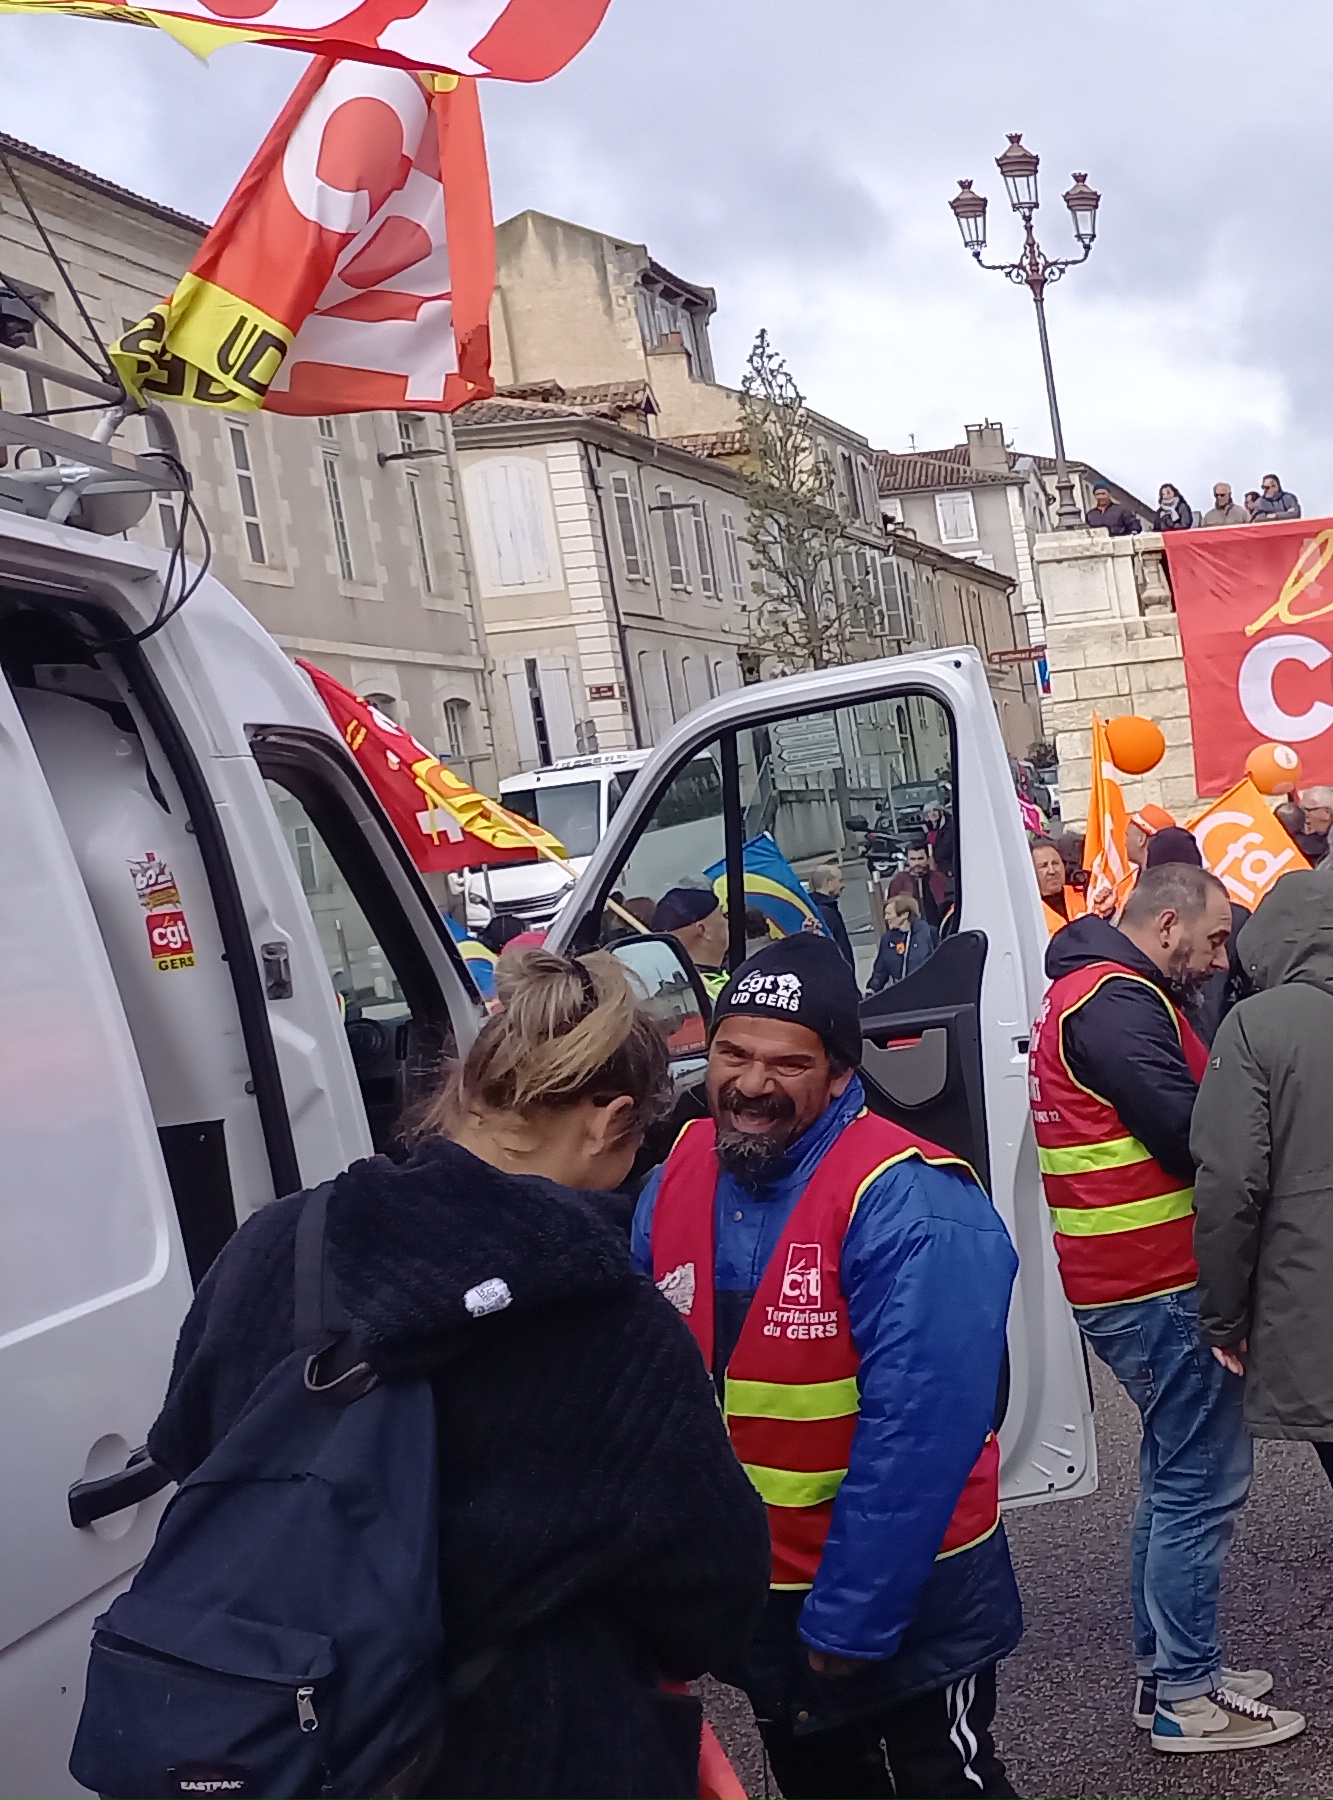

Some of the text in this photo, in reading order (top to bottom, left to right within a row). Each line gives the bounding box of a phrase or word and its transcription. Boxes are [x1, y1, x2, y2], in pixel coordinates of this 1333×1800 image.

[1191, 810, 1296, 904] Cfd
[152, 920, 189, 949] cgt
[158, 955, 195, 972] GERS
[737, 974, 776, 993] cgt
[730, 991, 799, 1012] UD GERS
[763, 1322, 838, 1340] du GERS
